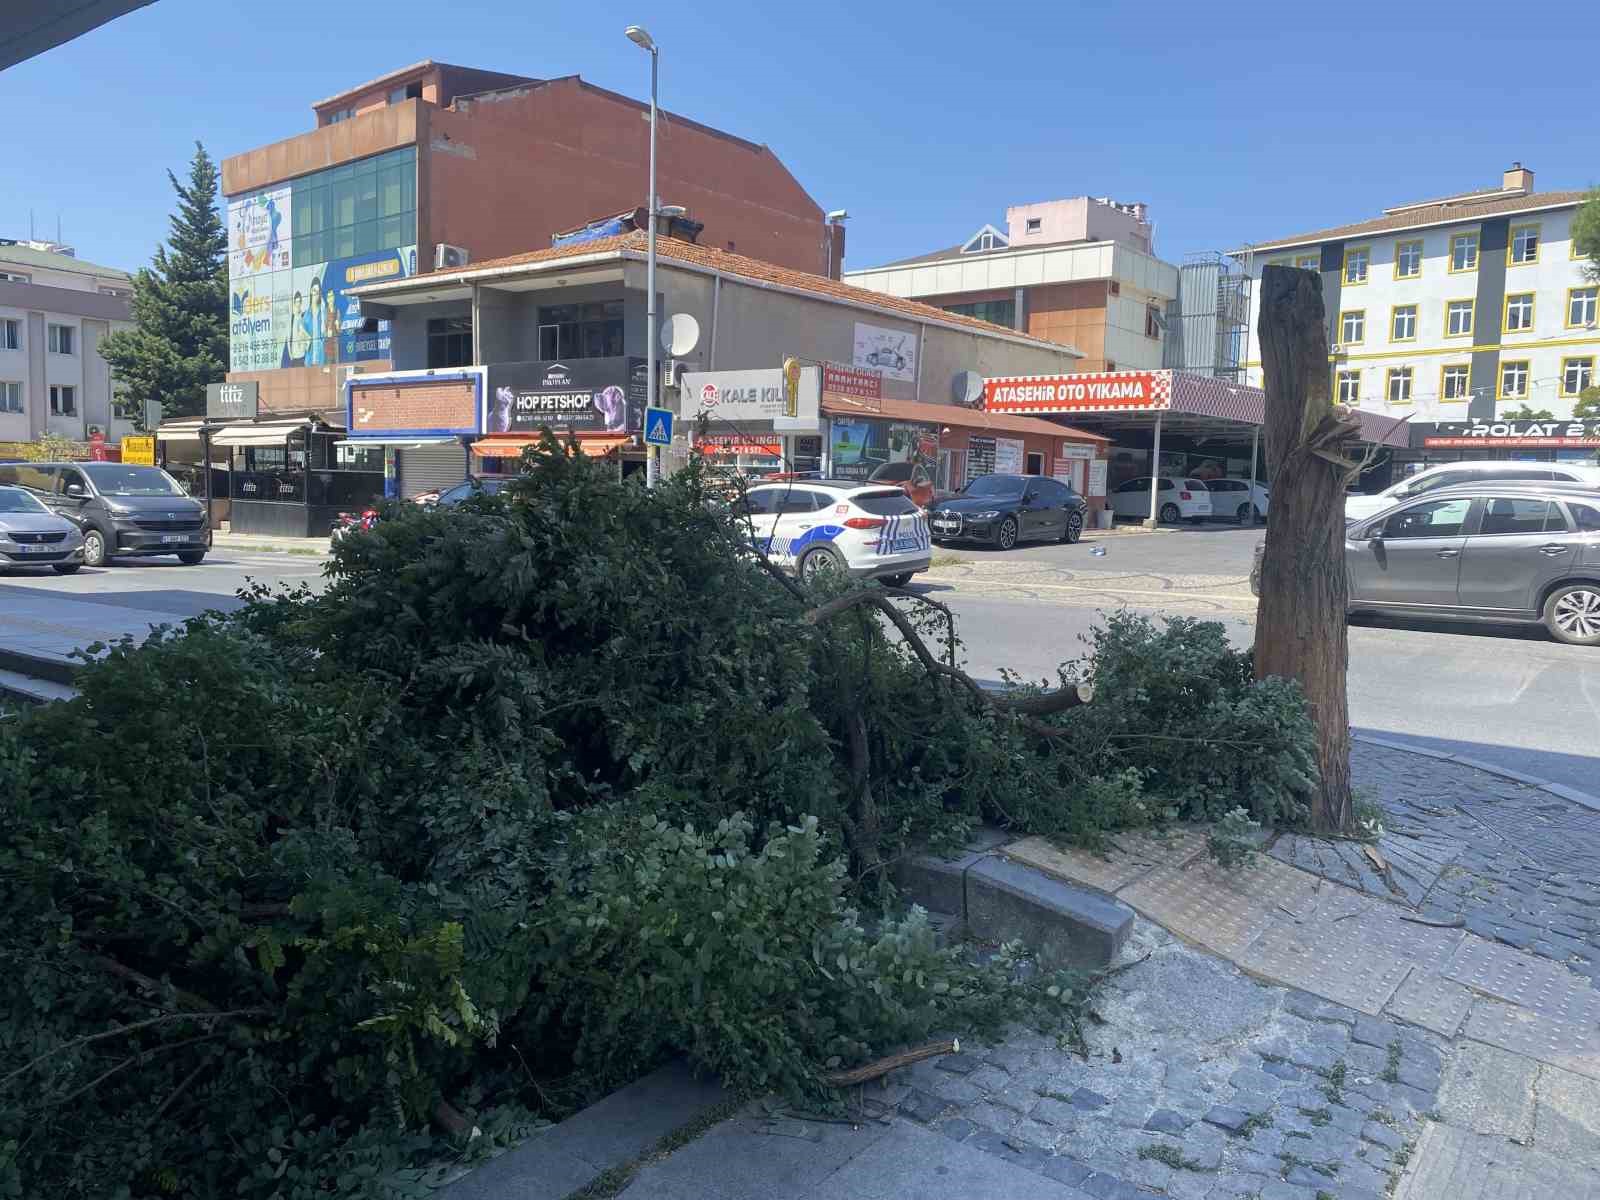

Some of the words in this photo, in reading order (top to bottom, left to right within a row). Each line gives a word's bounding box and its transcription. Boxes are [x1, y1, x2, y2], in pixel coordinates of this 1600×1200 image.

[220, 385, 243, 402] titiz
[722, 388, 757, 403] KALE
[1058, 384, 1085, 401] OTO
[1088, 383, 1144, 400] YIKAMA
[516, 395, 539, 409] HOP
[540, 394, 591, 408] PETSHOP
[1567, 424, 1585, 437] 2
